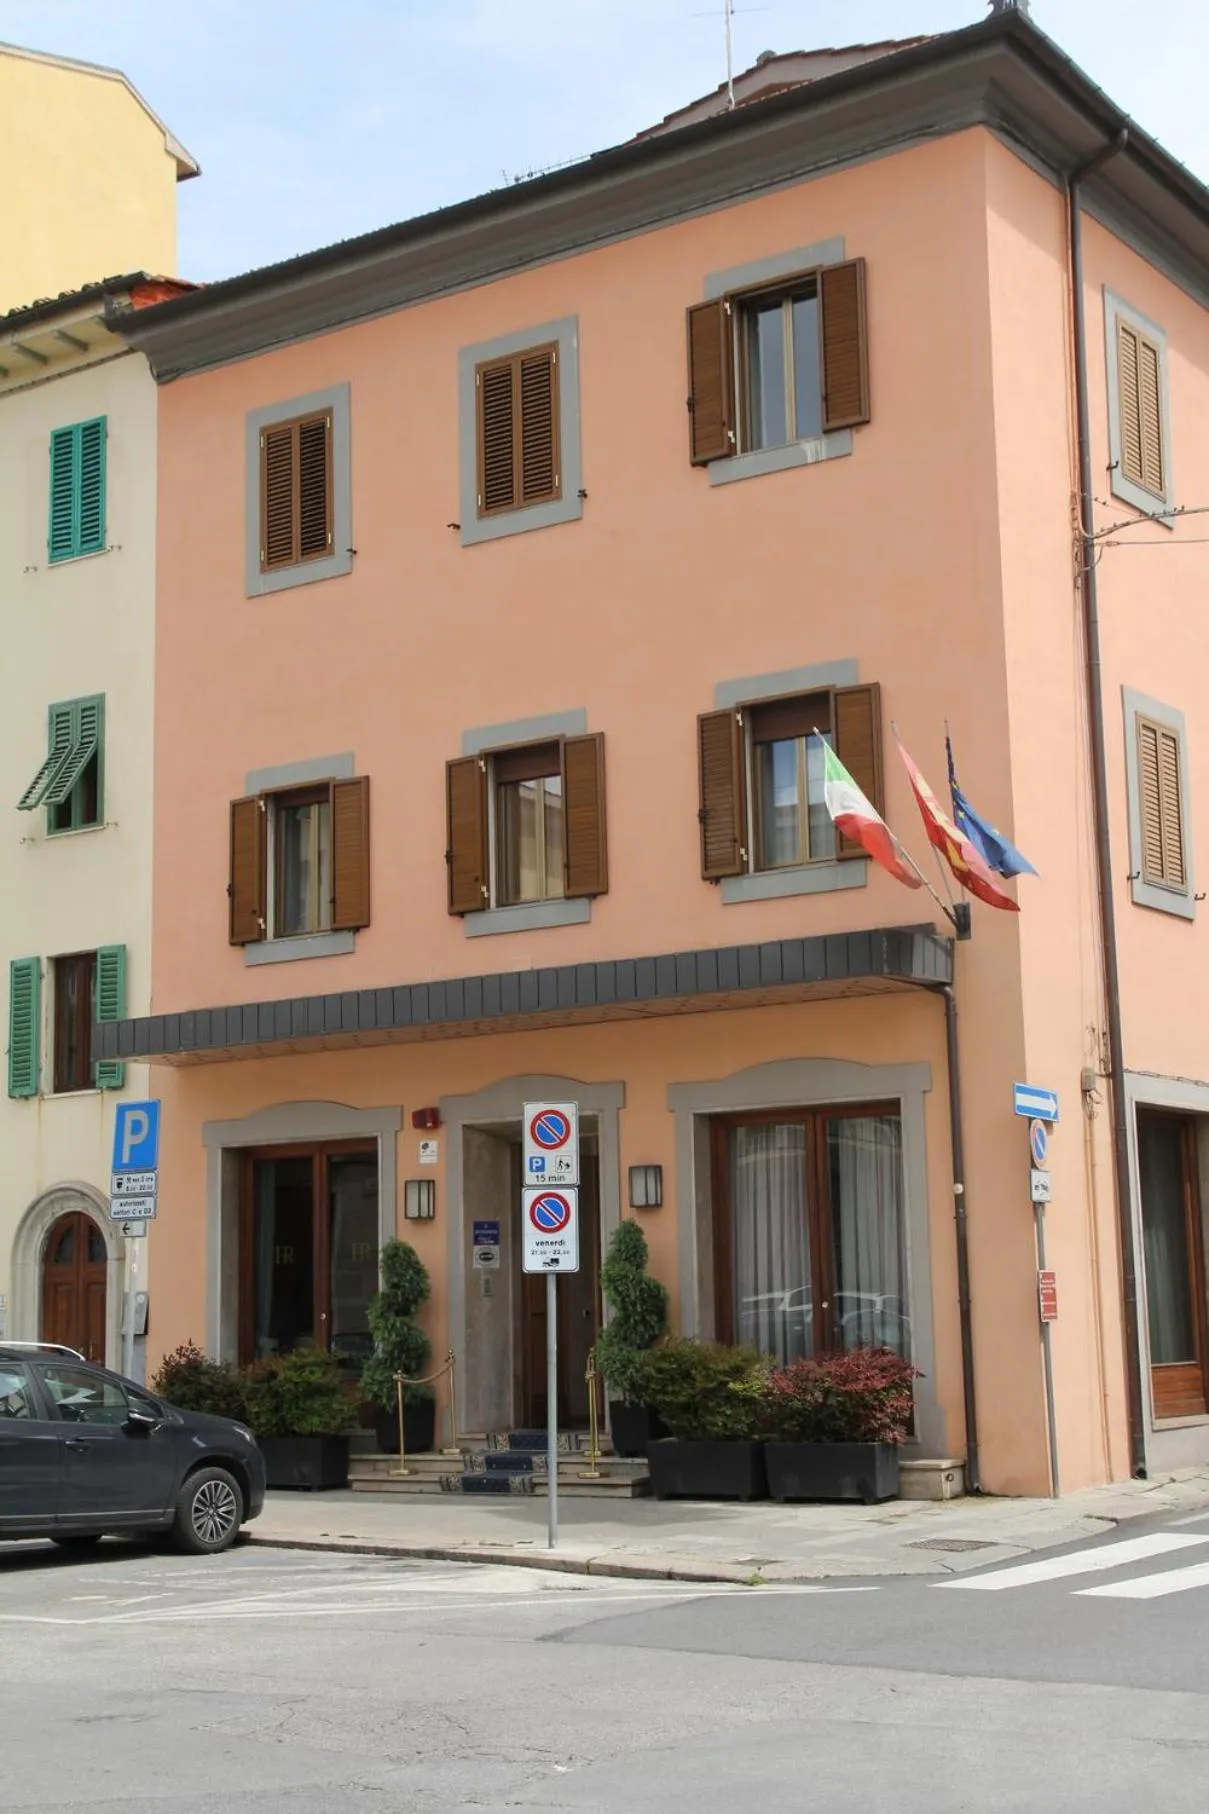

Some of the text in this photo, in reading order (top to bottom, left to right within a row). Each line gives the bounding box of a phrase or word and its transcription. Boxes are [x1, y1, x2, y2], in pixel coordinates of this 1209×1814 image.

[121, 1110, 149, 1164] P
[532, 1158, 543, 1171] P
[535, 1174, 566, 1183] 15 min
